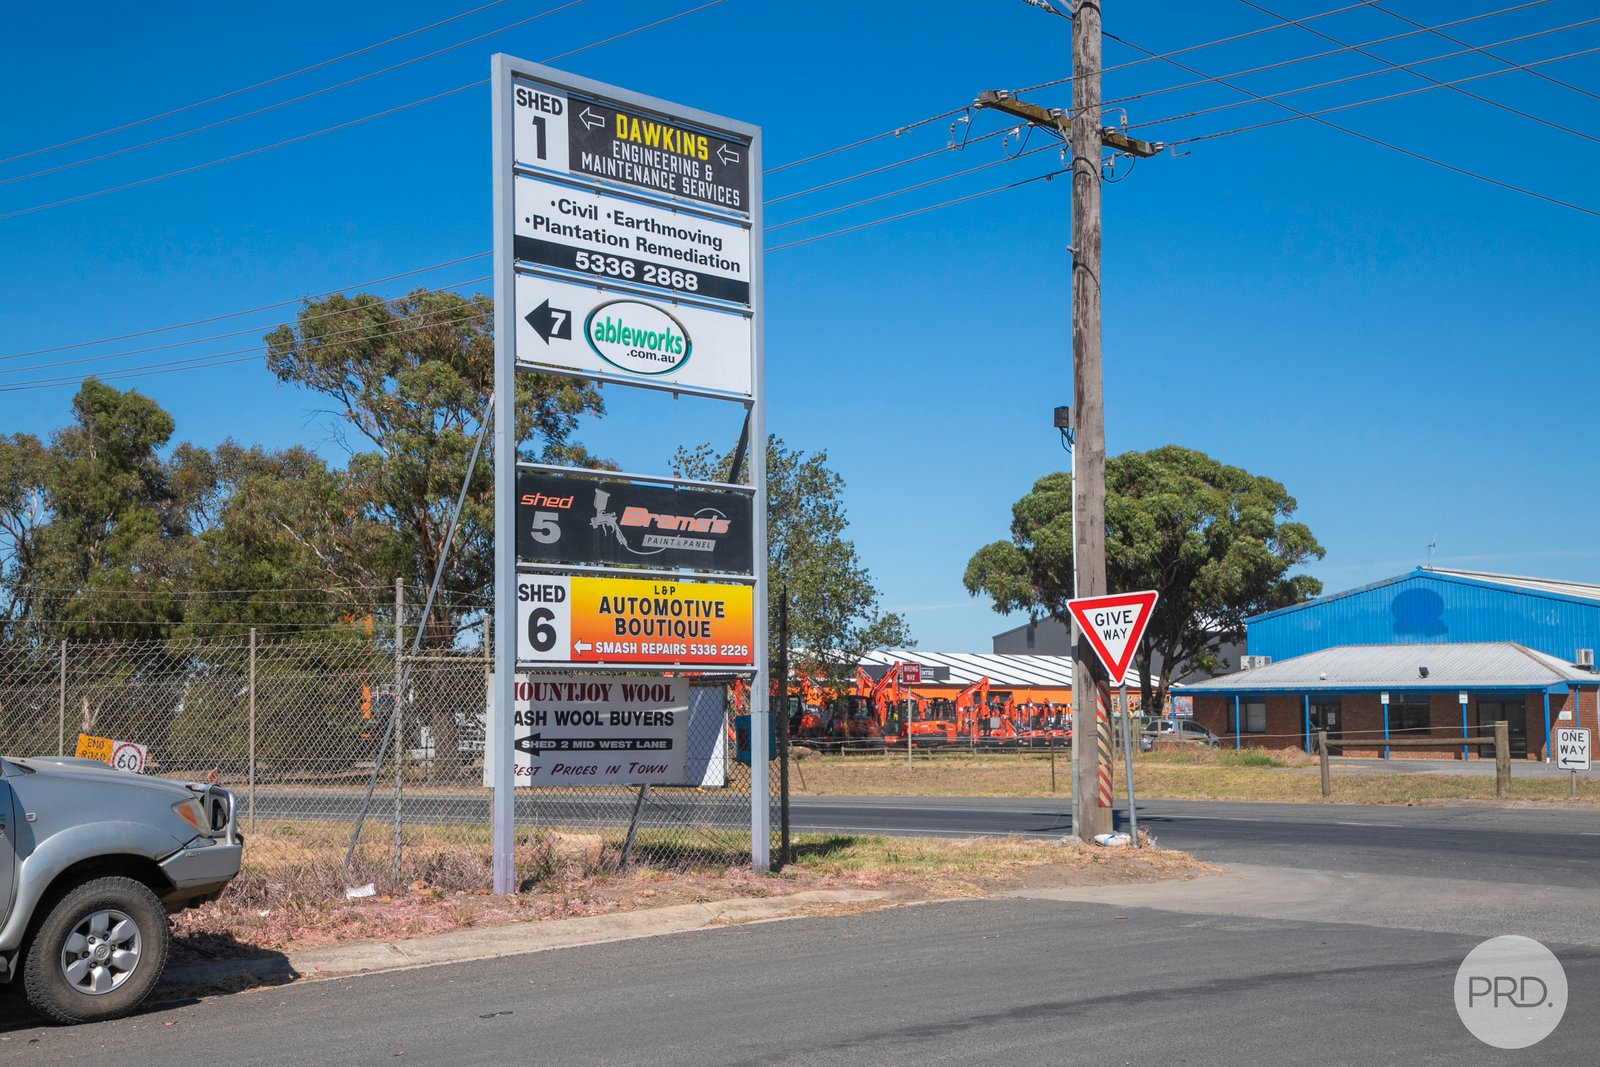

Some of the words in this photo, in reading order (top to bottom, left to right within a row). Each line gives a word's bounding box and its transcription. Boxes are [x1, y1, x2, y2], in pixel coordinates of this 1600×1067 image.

[515, 88, 564, 116] SHED
[531, 115, 548, 161] 1
[615, 113, 710, 161] DAWKINS
[612, 139, 700, 178] ENGINEERING
[704, 163, 714, 182] &
[581, 151, 676, 191] MAINTENANCE
[682, 176, 741, 207] SERVICES
[557, 198, 599, 221] Civil
[613, 210, 723, 251] Earthmoving
[532, 214, 630, 249] Plantation
[635, 236, 741, 273] Remediation
[574, 251, 636, 279] 5336
[643, 265, 699, 291] 2868
[550, 311, 567, 335] 7
[593, 316, 684, 356] ableworks
[626, 349, 676, 365] .com.au
[520, 492, 575, 509] shed
[530, 511, 562, 544] 5
[620, 506, 732, 534] Brame's
[646, 537, 676, 546] PAINT
[682, 539, 712, 549] PANEL
[518, 583, 567, 604] SHED
[598, 596, 726, 619] AUTOMOTIVE
[1095, 610, 1133, 626] GIVE
[527, 607, 557, 653] 6
[614, 617, 712, 639] BOUTIQUE
[1103, 628, 1127, 640] WAY
[595, 641, 637, 655] SMASH
[641, 643, 687, 656] REPAIRS
[690, 643, 717, 656] 5336
[720, 645, 748, 656] 2226
[621, 683, 675, 702] WOOL
[555, 711, 604, 726] WOOL
[610, 711, 674, 727] BUYERS
[521, 740, 557, 749] SHED
[561, 740, 569, 749] 2
[572, 740, 595, 749] MID
[599, 740, 634, 749] WEST
[642, 740, 667, 749] LANE
[1561, 731, 1585, 742] ONE
[1560, 744, 1586, 755] WAY
[117, 753, 137, 770] 60
